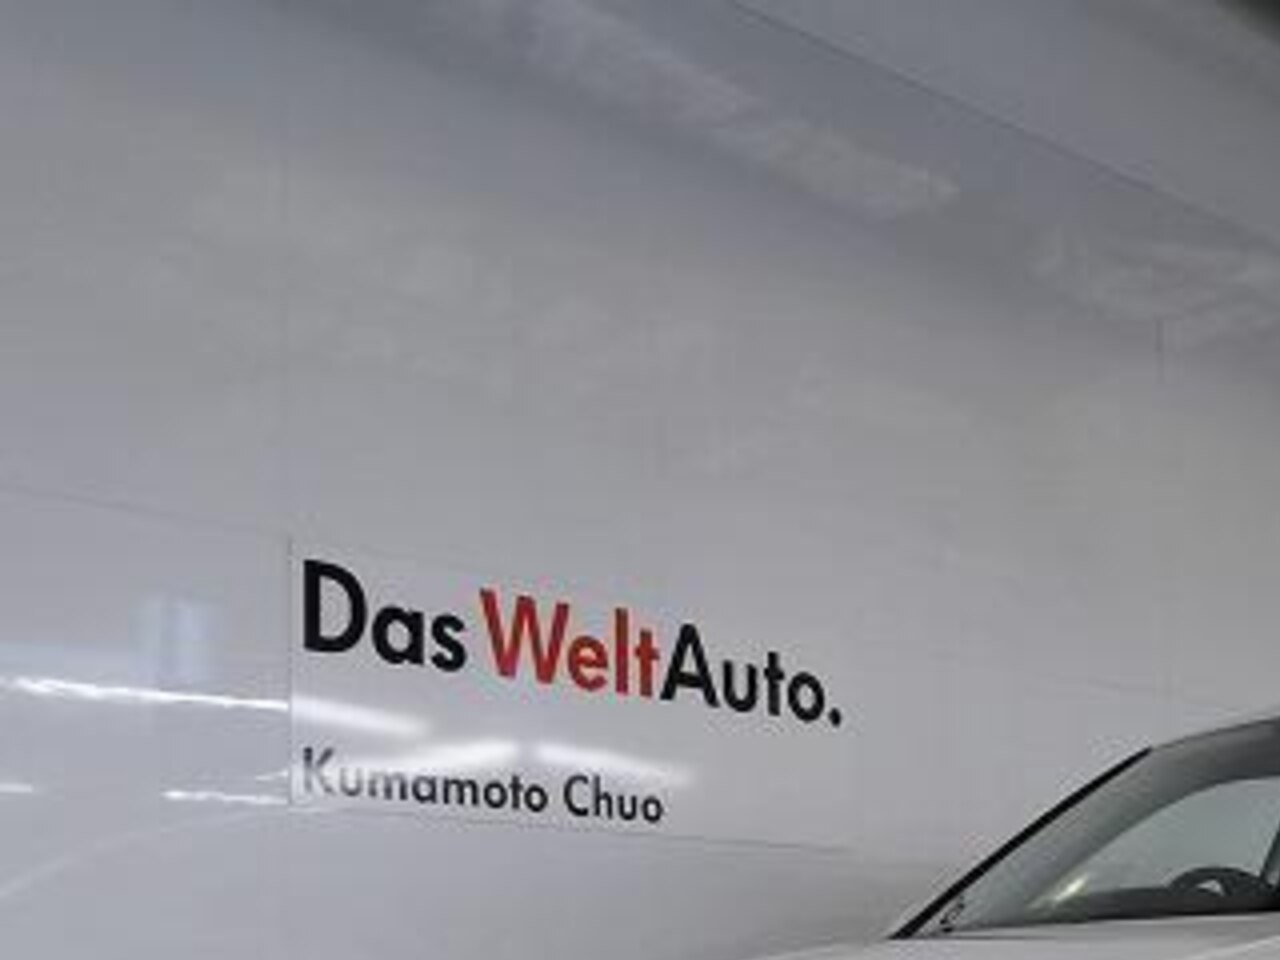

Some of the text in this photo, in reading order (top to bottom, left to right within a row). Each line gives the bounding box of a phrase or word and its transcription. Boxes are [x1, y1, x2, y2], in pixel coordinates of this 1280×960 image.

[303, 559, 468, 671] Das
[303, 747, 664, 823] Kumamoto Chuo
